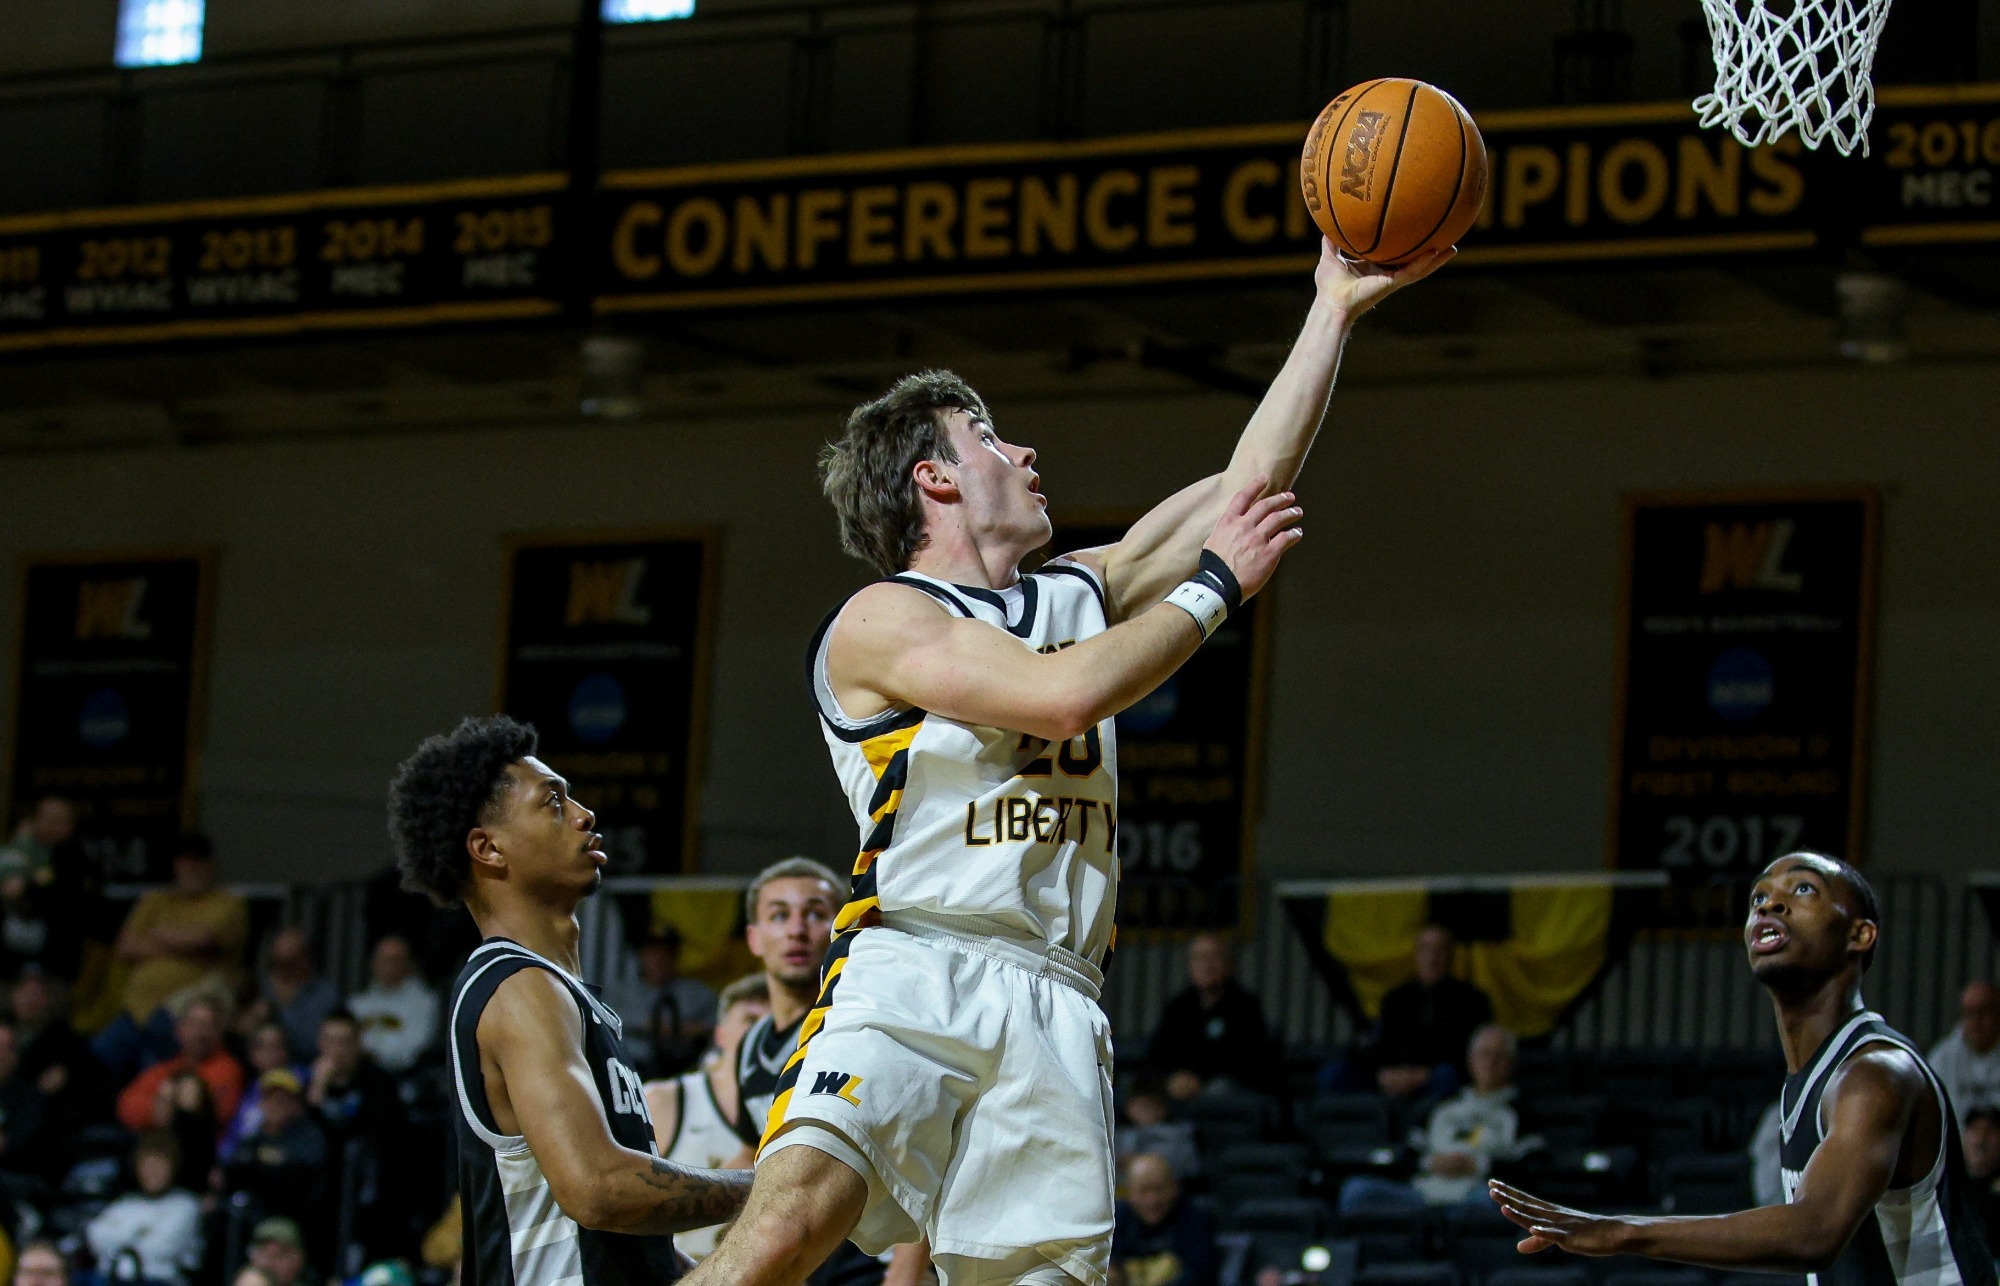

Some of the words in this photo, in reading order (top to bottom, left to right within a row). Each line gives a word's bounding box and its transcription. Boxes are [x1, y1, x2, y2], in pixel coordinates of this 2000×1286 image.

[1340, 111, 1384, 201] NCAA
[611, 165, 1199, 279] CONFERENCE
[1222, 133, 1806, 244] CPIONS
[1901, 170, 1993, 208] MEC
[319, 216, 426, 263] 2014
[452, 204, 554, 254] 2015
[1700, 518, 1802, 594] WL
[965, 797, 1117, 854] LIBERTY
[1119, 820, 1201, 871] 016
[1660, 815, 1804, 867] 2017
[809, 1070, 864, 1107] WL
